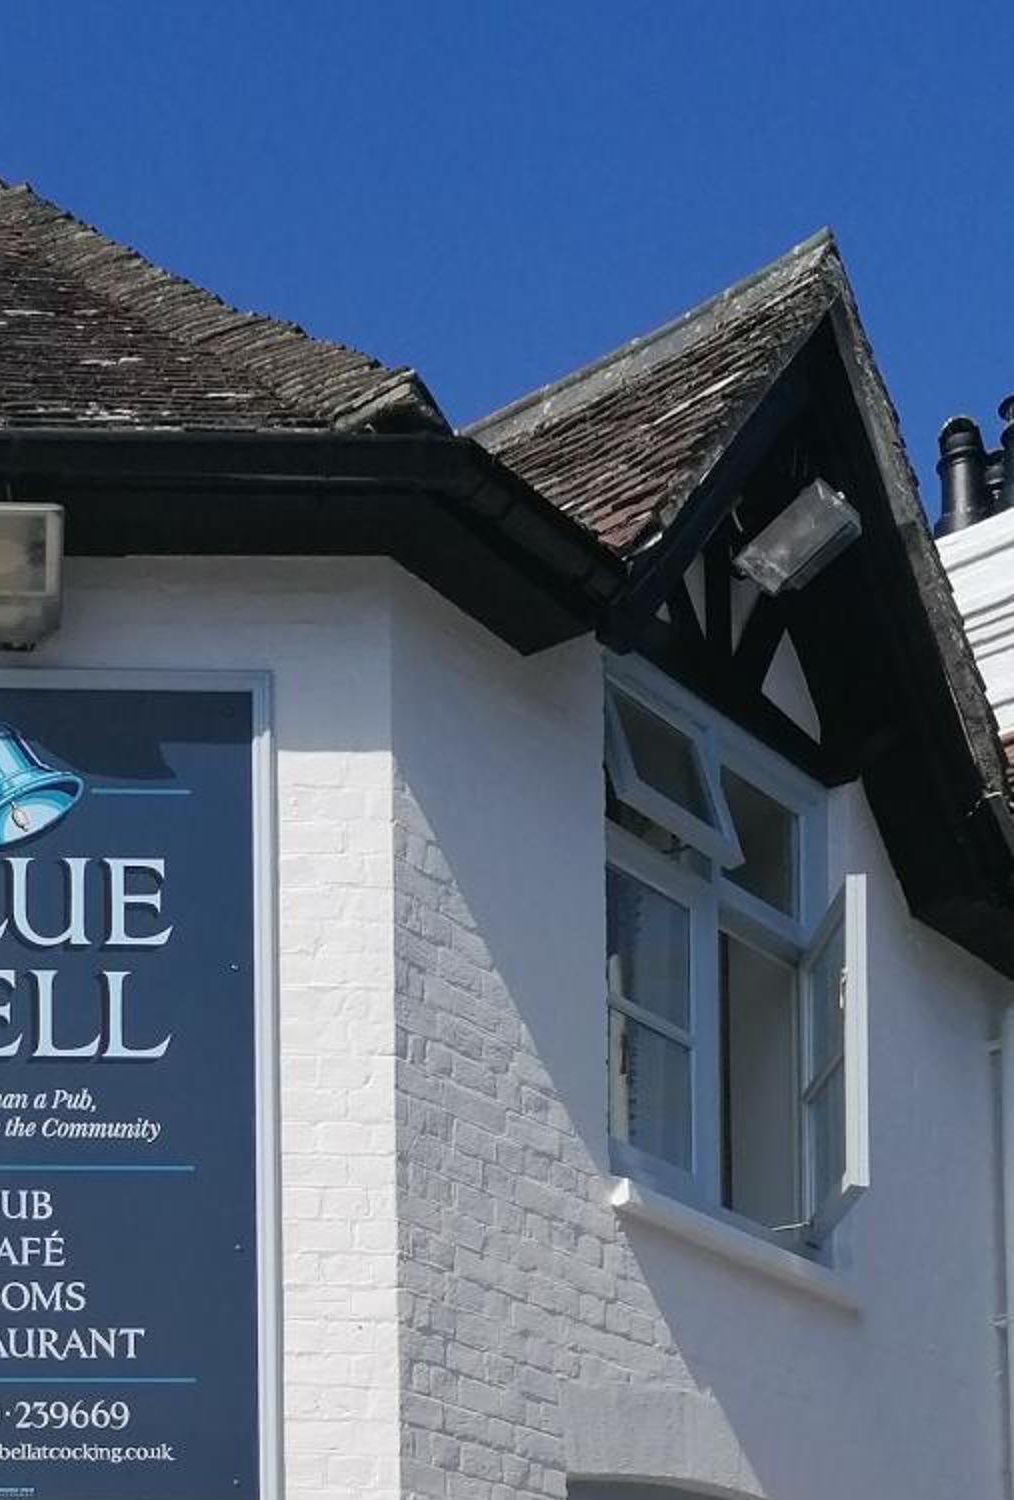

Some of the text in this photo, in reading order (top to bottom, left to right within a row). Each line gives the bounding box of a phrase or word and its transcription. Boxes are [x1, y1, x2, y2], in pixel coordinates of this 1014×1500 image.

[33, 1094, 47, 1109] a
[51, 1089, 97, 1112] Pub,
[4, 1117, 37, 1137] the
[41, 1117, 162, 1142] Community
